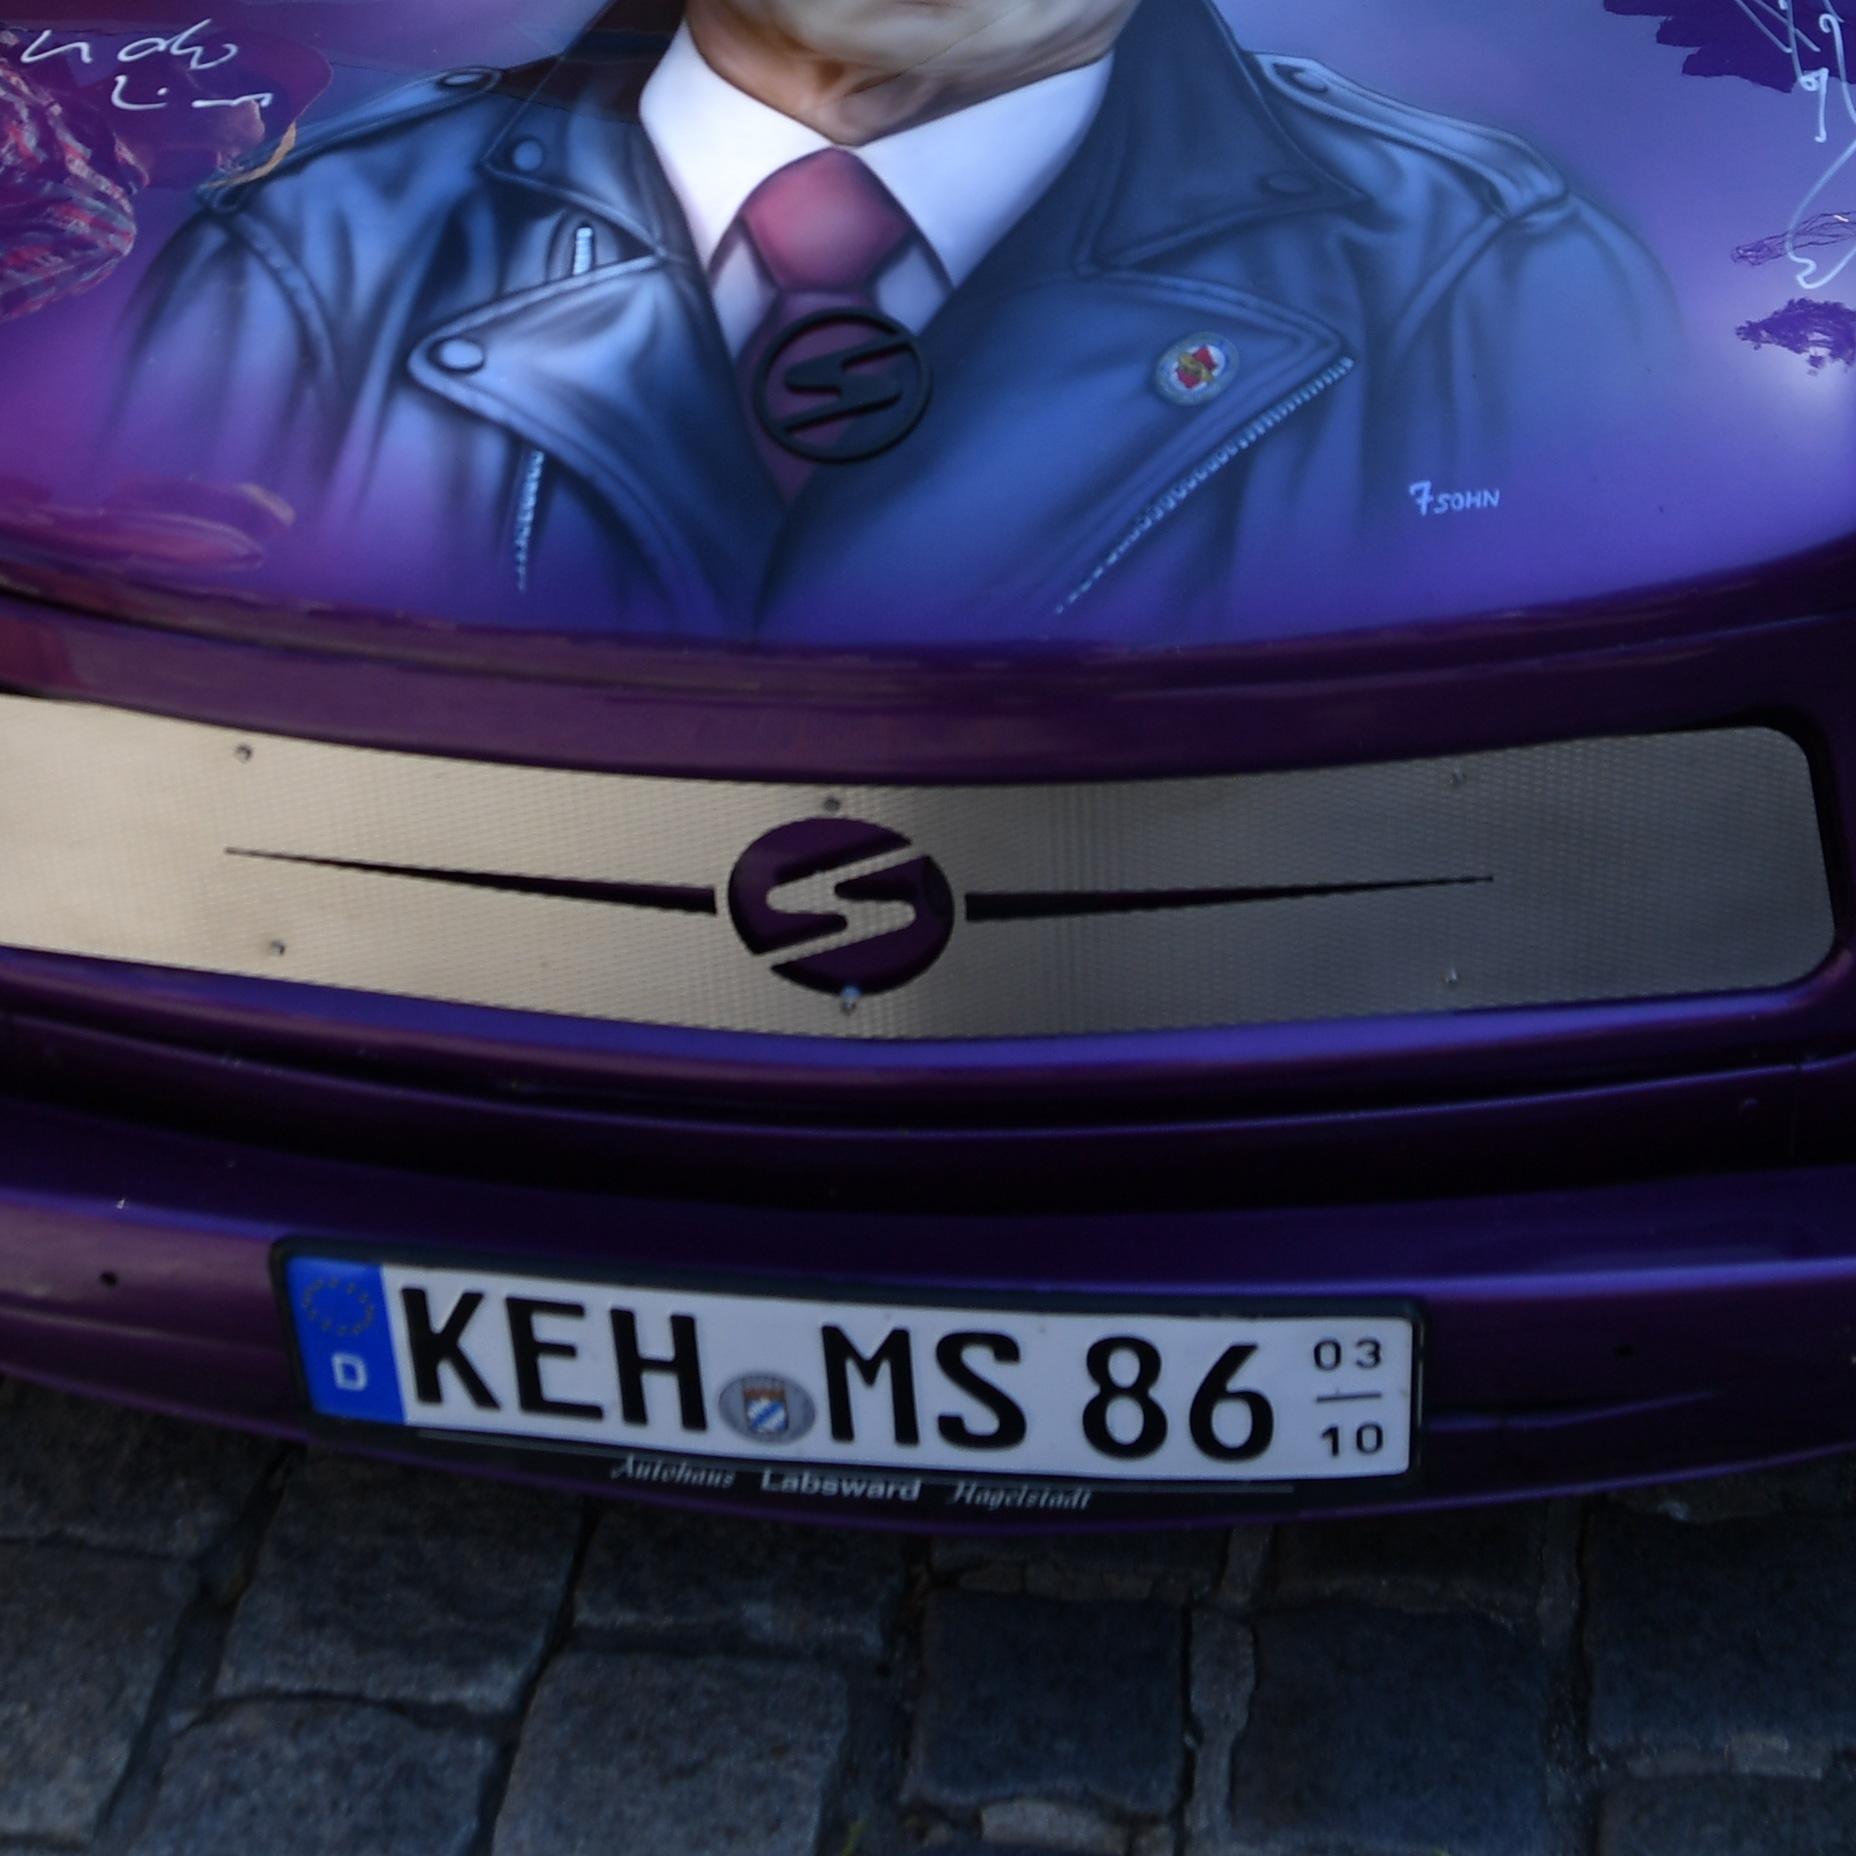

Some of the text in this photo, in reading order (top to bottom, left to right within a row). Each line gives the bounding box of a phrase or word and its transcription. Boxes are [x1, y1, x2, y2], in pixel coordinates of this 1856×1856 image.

[331, 1352, 369, 1392] D
[399, 1286, 1383, 1463] KEH MS 86 03
[1320, 1422, 1386, 1457] 10
[610, 1453, 1092, 1512] Autohaus Labsward Hagelstadt
